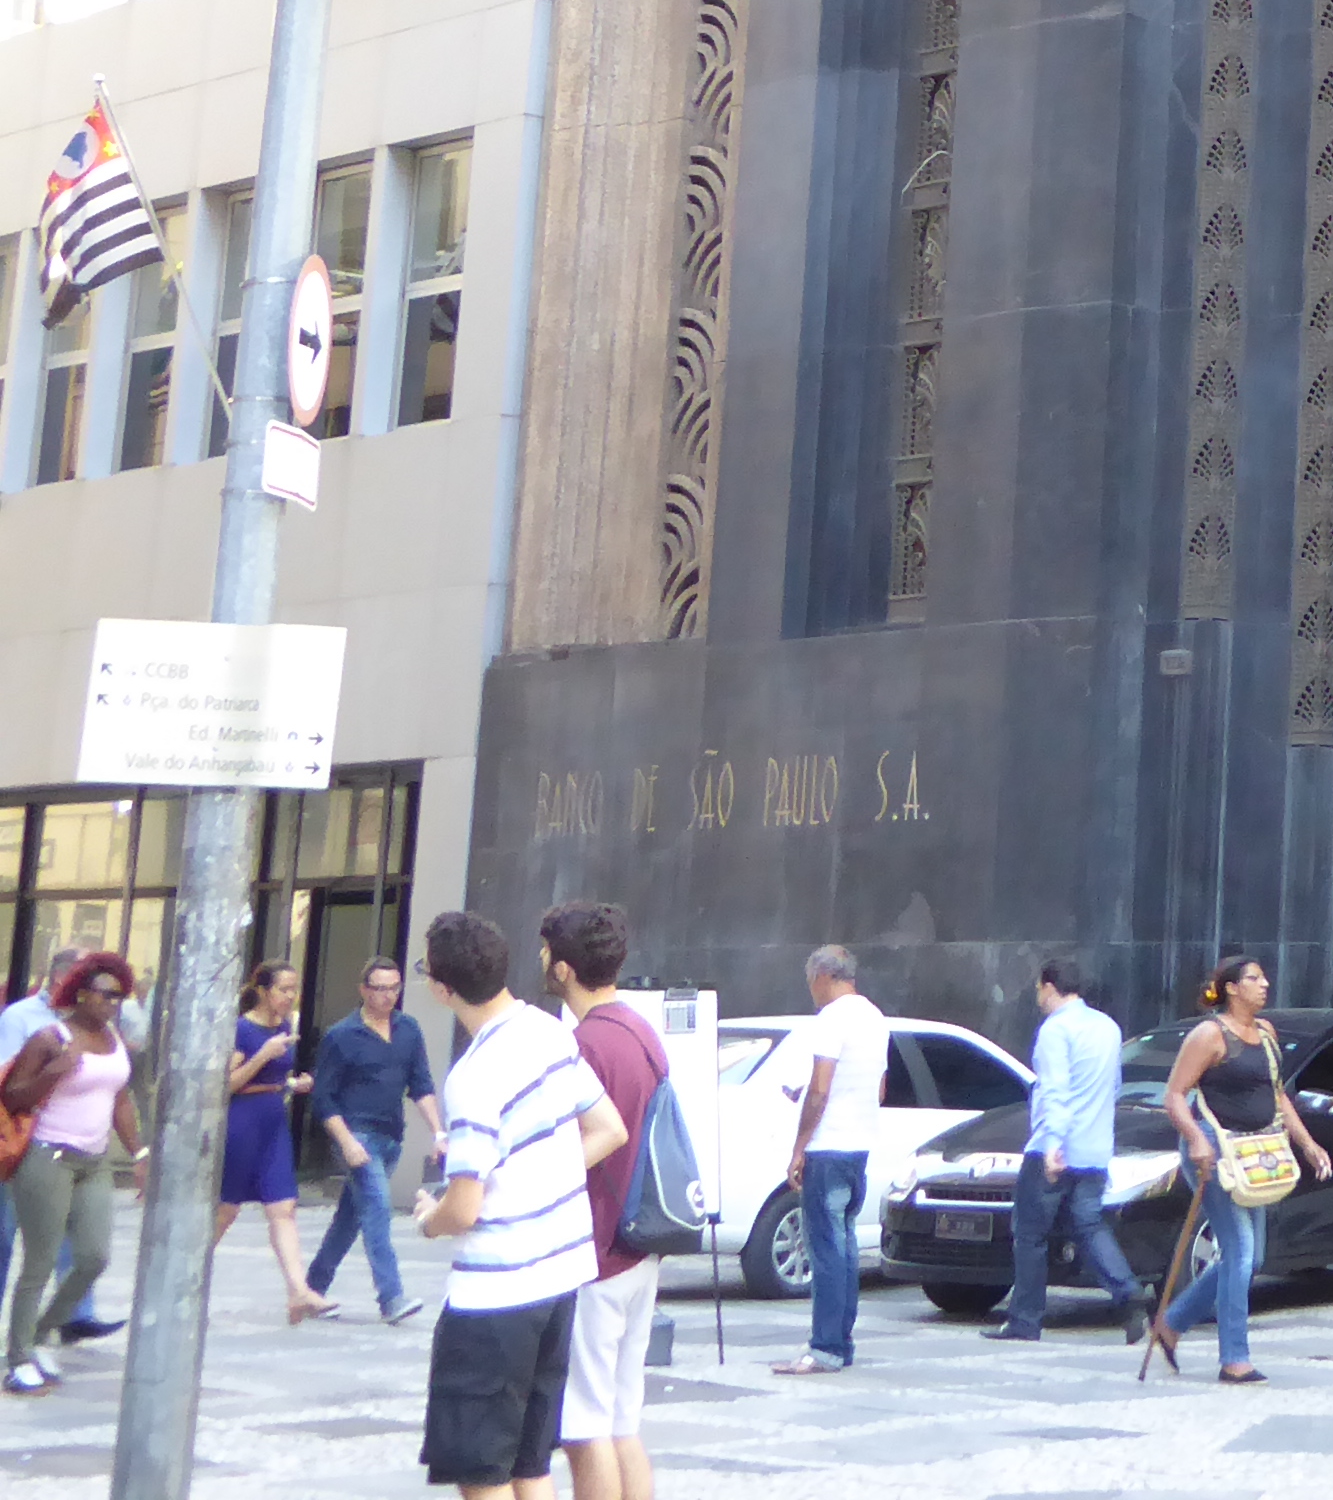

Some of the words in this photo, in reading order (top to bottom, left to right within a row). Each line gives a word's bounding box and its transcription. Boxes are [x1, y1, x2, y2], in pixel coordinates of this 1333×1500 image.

[535, 770, 604, 837] BANCO
[630, 764, 660, 833] DE
[686, 749, 734, 832] SÃO
[763, 754, 840, 827] PAULO
[873, 749, 931, 822] S.A.
